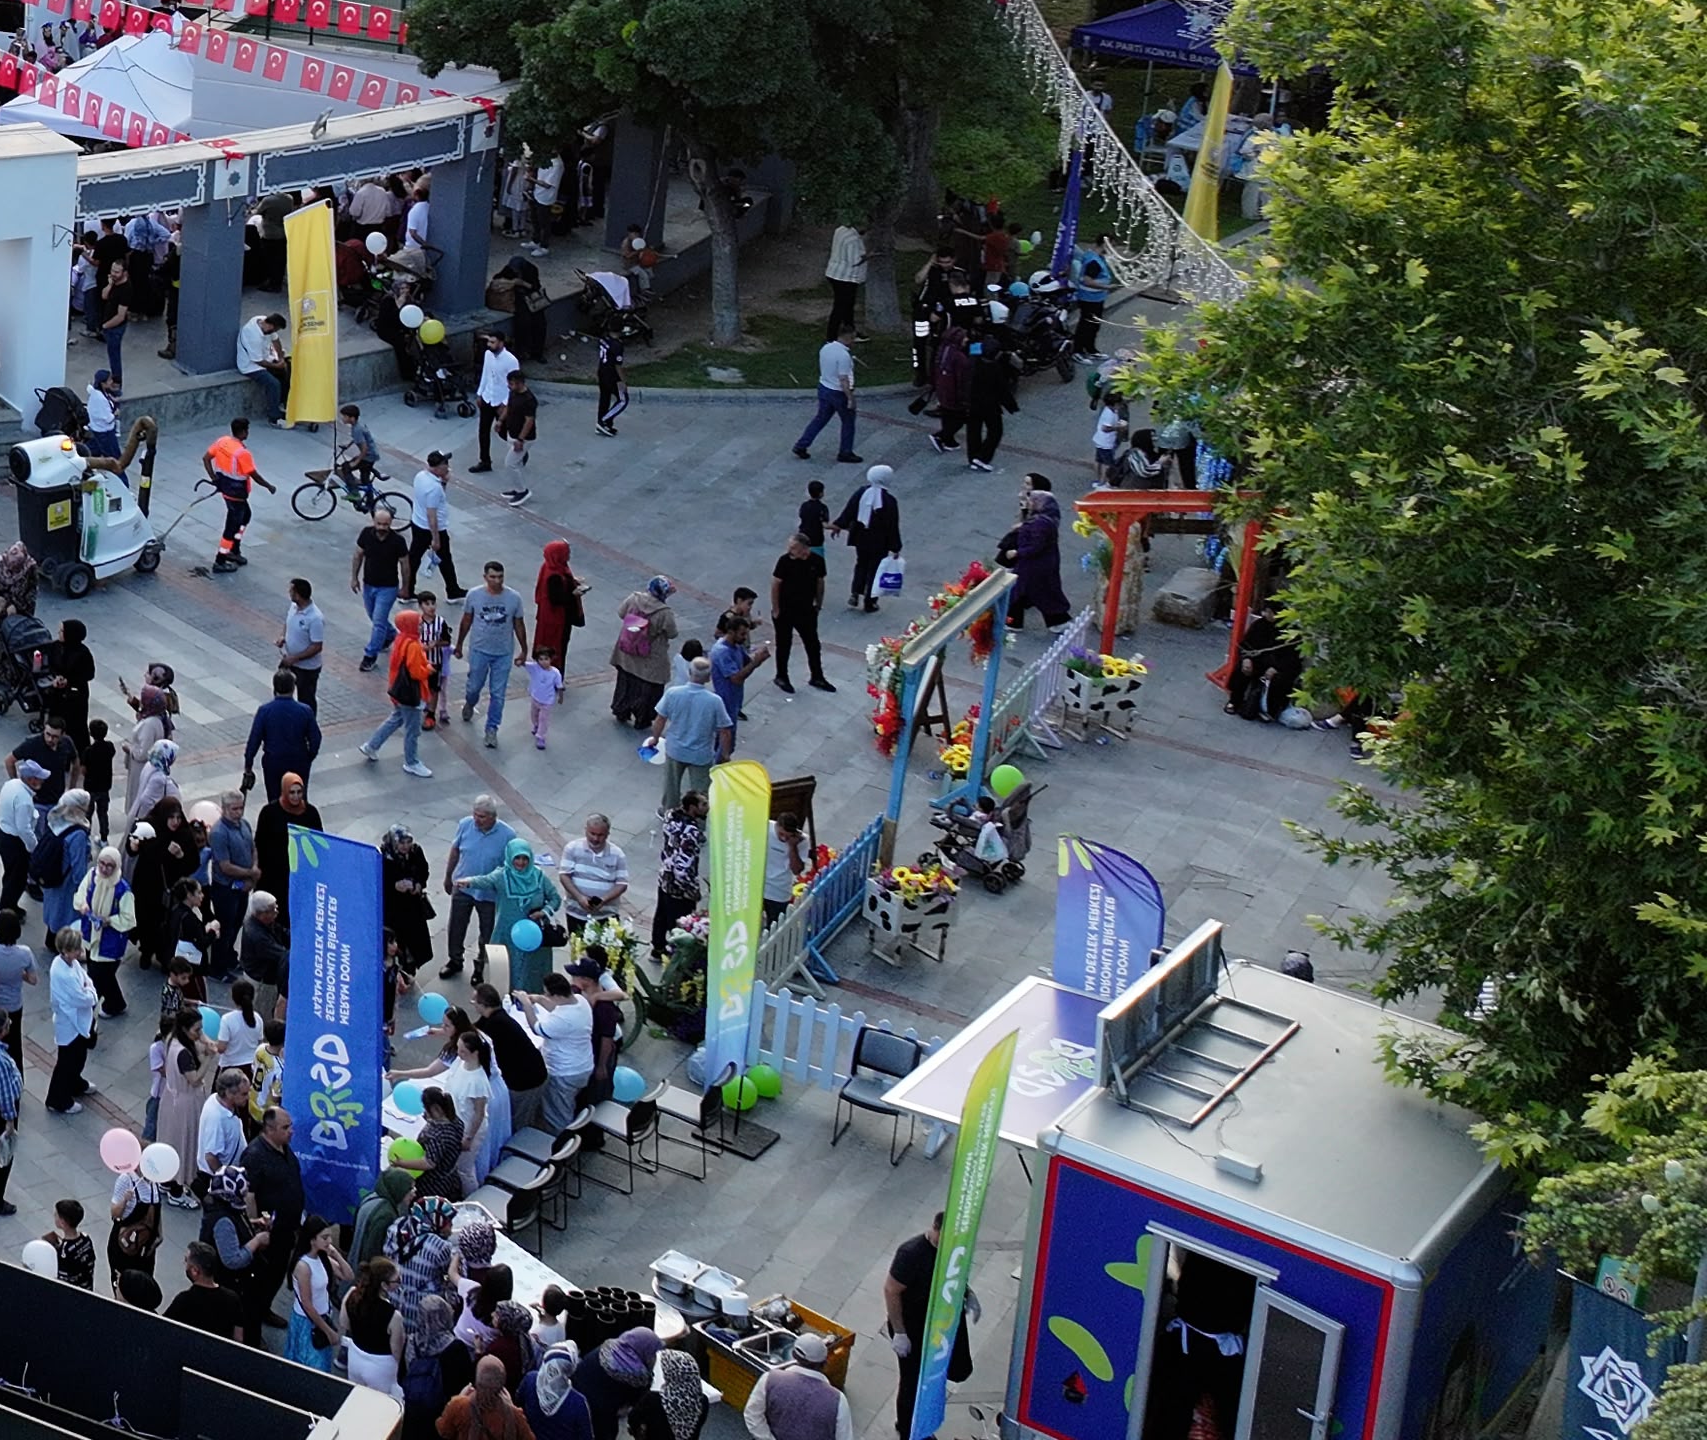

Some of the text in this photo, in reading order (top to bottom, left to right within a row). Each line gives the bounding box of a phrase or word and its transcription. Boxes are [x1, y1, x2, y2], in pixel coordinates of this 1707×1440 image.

[1100, 39, 1114, 48] AK
[1116, 42, 1143, 54] PARTİ
[1144, 46, 1177, 59] KONYA
[1178, 50, 1186, 61] İL
